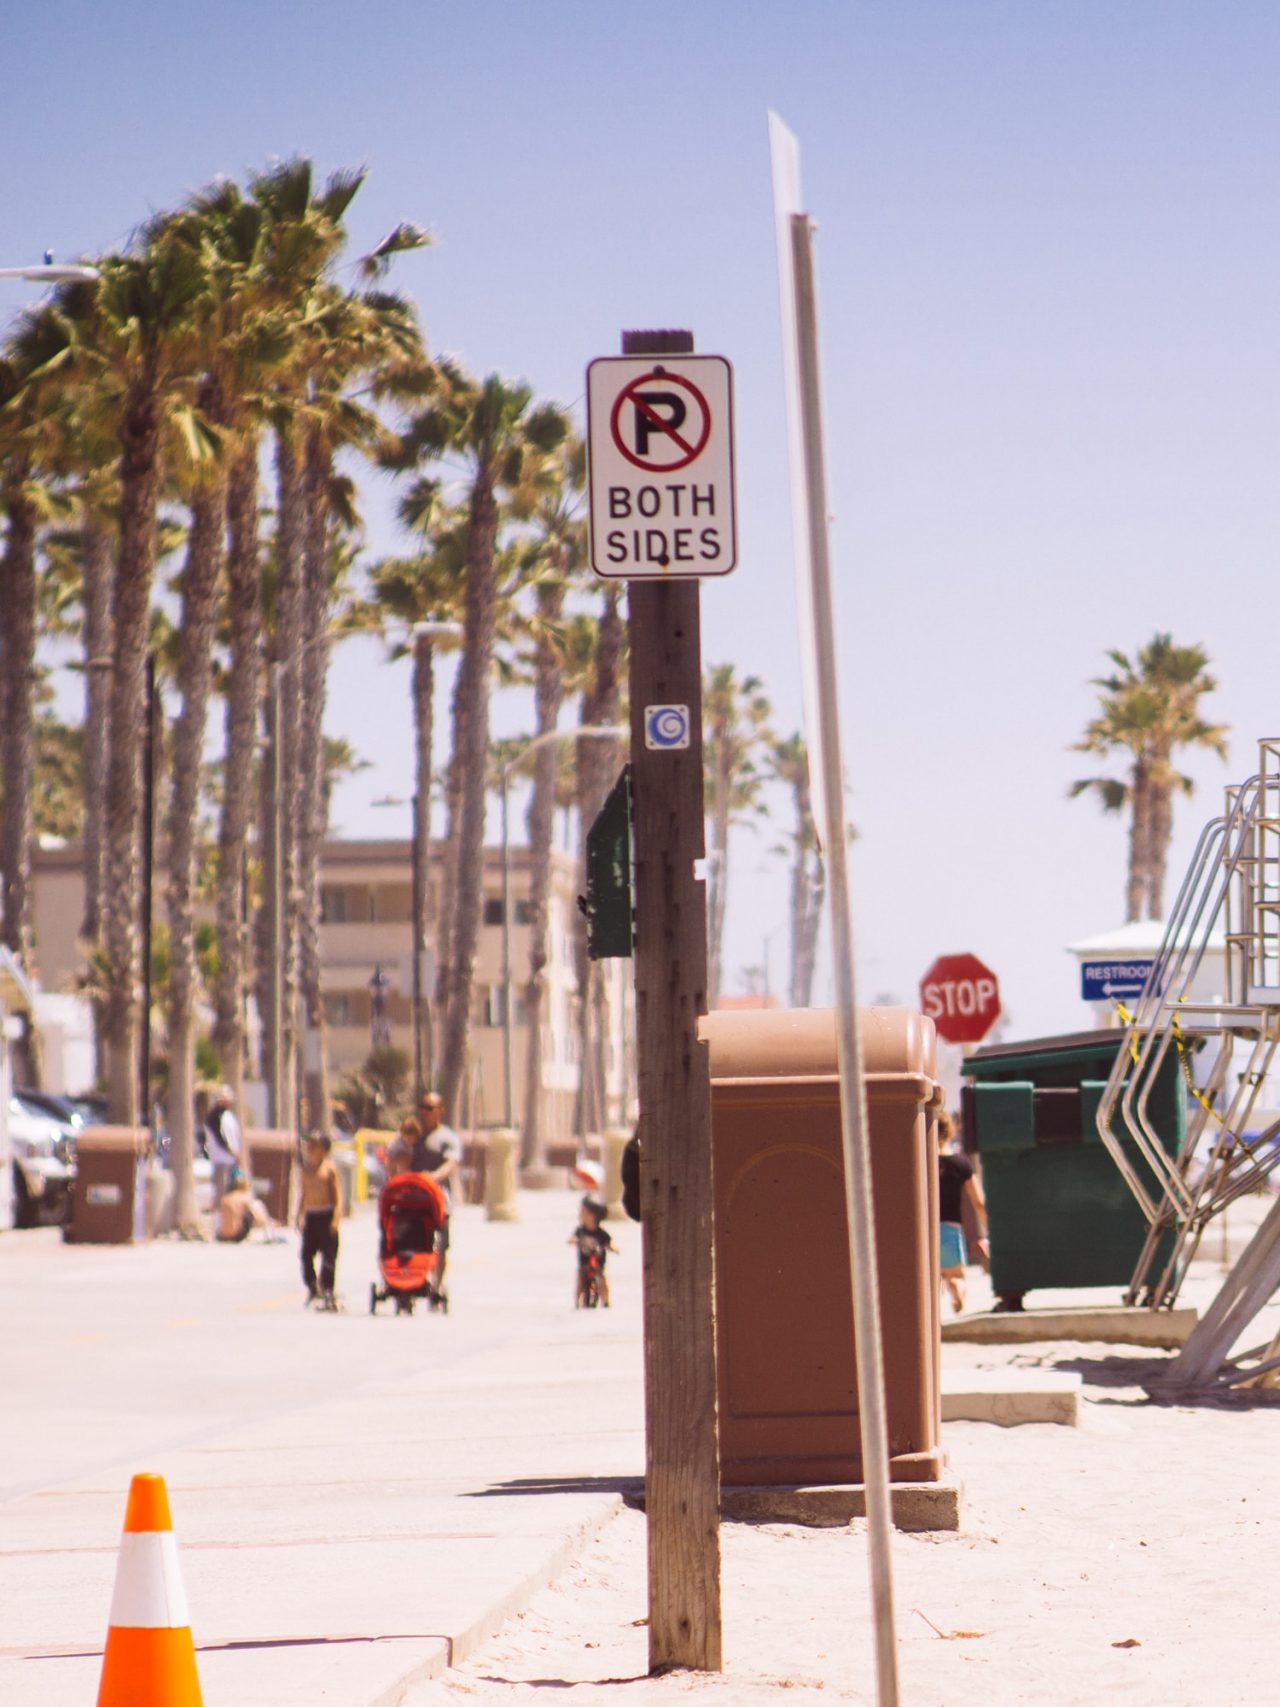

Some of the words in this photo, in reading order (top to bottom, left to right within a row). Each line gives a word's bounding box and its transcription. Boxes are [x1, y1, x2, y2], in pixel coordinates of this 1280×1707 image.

[634, 391, 687, 455] P
[608, 483, 715, 519] BOTH
[606, 527, 721, 563] SIDES
[923, 979, 996, 1018] STOP
